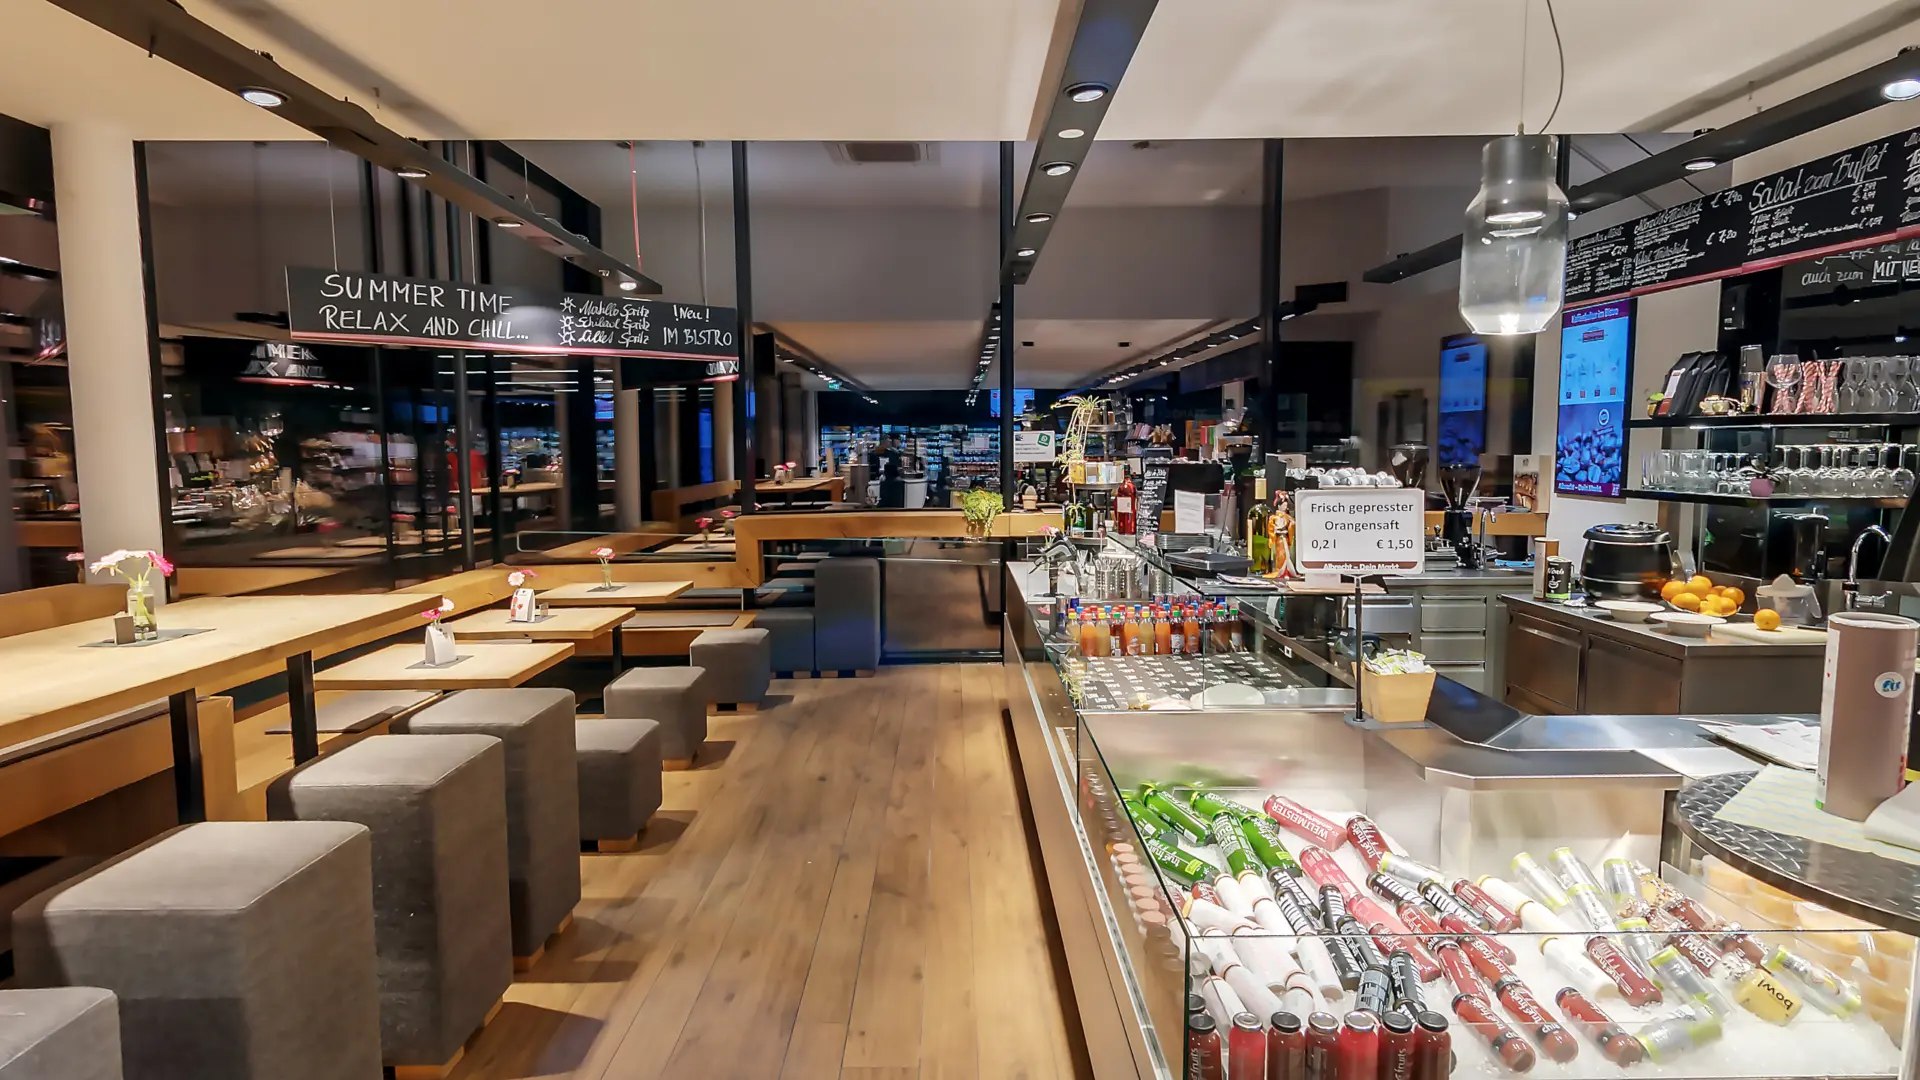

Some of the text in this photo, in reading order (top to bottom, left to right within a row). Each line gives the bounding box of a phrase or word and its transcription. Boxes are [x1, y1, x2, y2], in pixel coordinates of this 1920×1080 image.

[1749, 169, 1804, 211] Salat
[1833, 143, 1889, 186] Buffet
[1802, 267, 1831, 285] auch
[1837, 272, 1863, 281] zum
[321, 273, 513, 315] SUMMER TIME
[319, 304, 408, 332] RELAX
[422, 315, 460, 336] AND
[620, 304, 650, 320] Spritz
[622, 318, 650, 335] Spritz
[618, 331, 649, 347] Spritz
[663, 327, 732, 346] IM BISTRO
[1311, 502, 1414, 514] Frisch gepresster
[1324, 520, 1399, 532] Orangensaft
[1311, 540, 1329, 550] 0,2
[1376, 540, 1384, 549] €
[1388, 540, 1414, 550] 1,50
[1271, 802, 1329, 839] WELTMEISTER
[1348, 823, 1377, 859] true fruits
[1162, 852, 1180, 867] true
[1505, 986, 1527, 1009] fruits
[1755, 977, 1794, 1012] bowl
